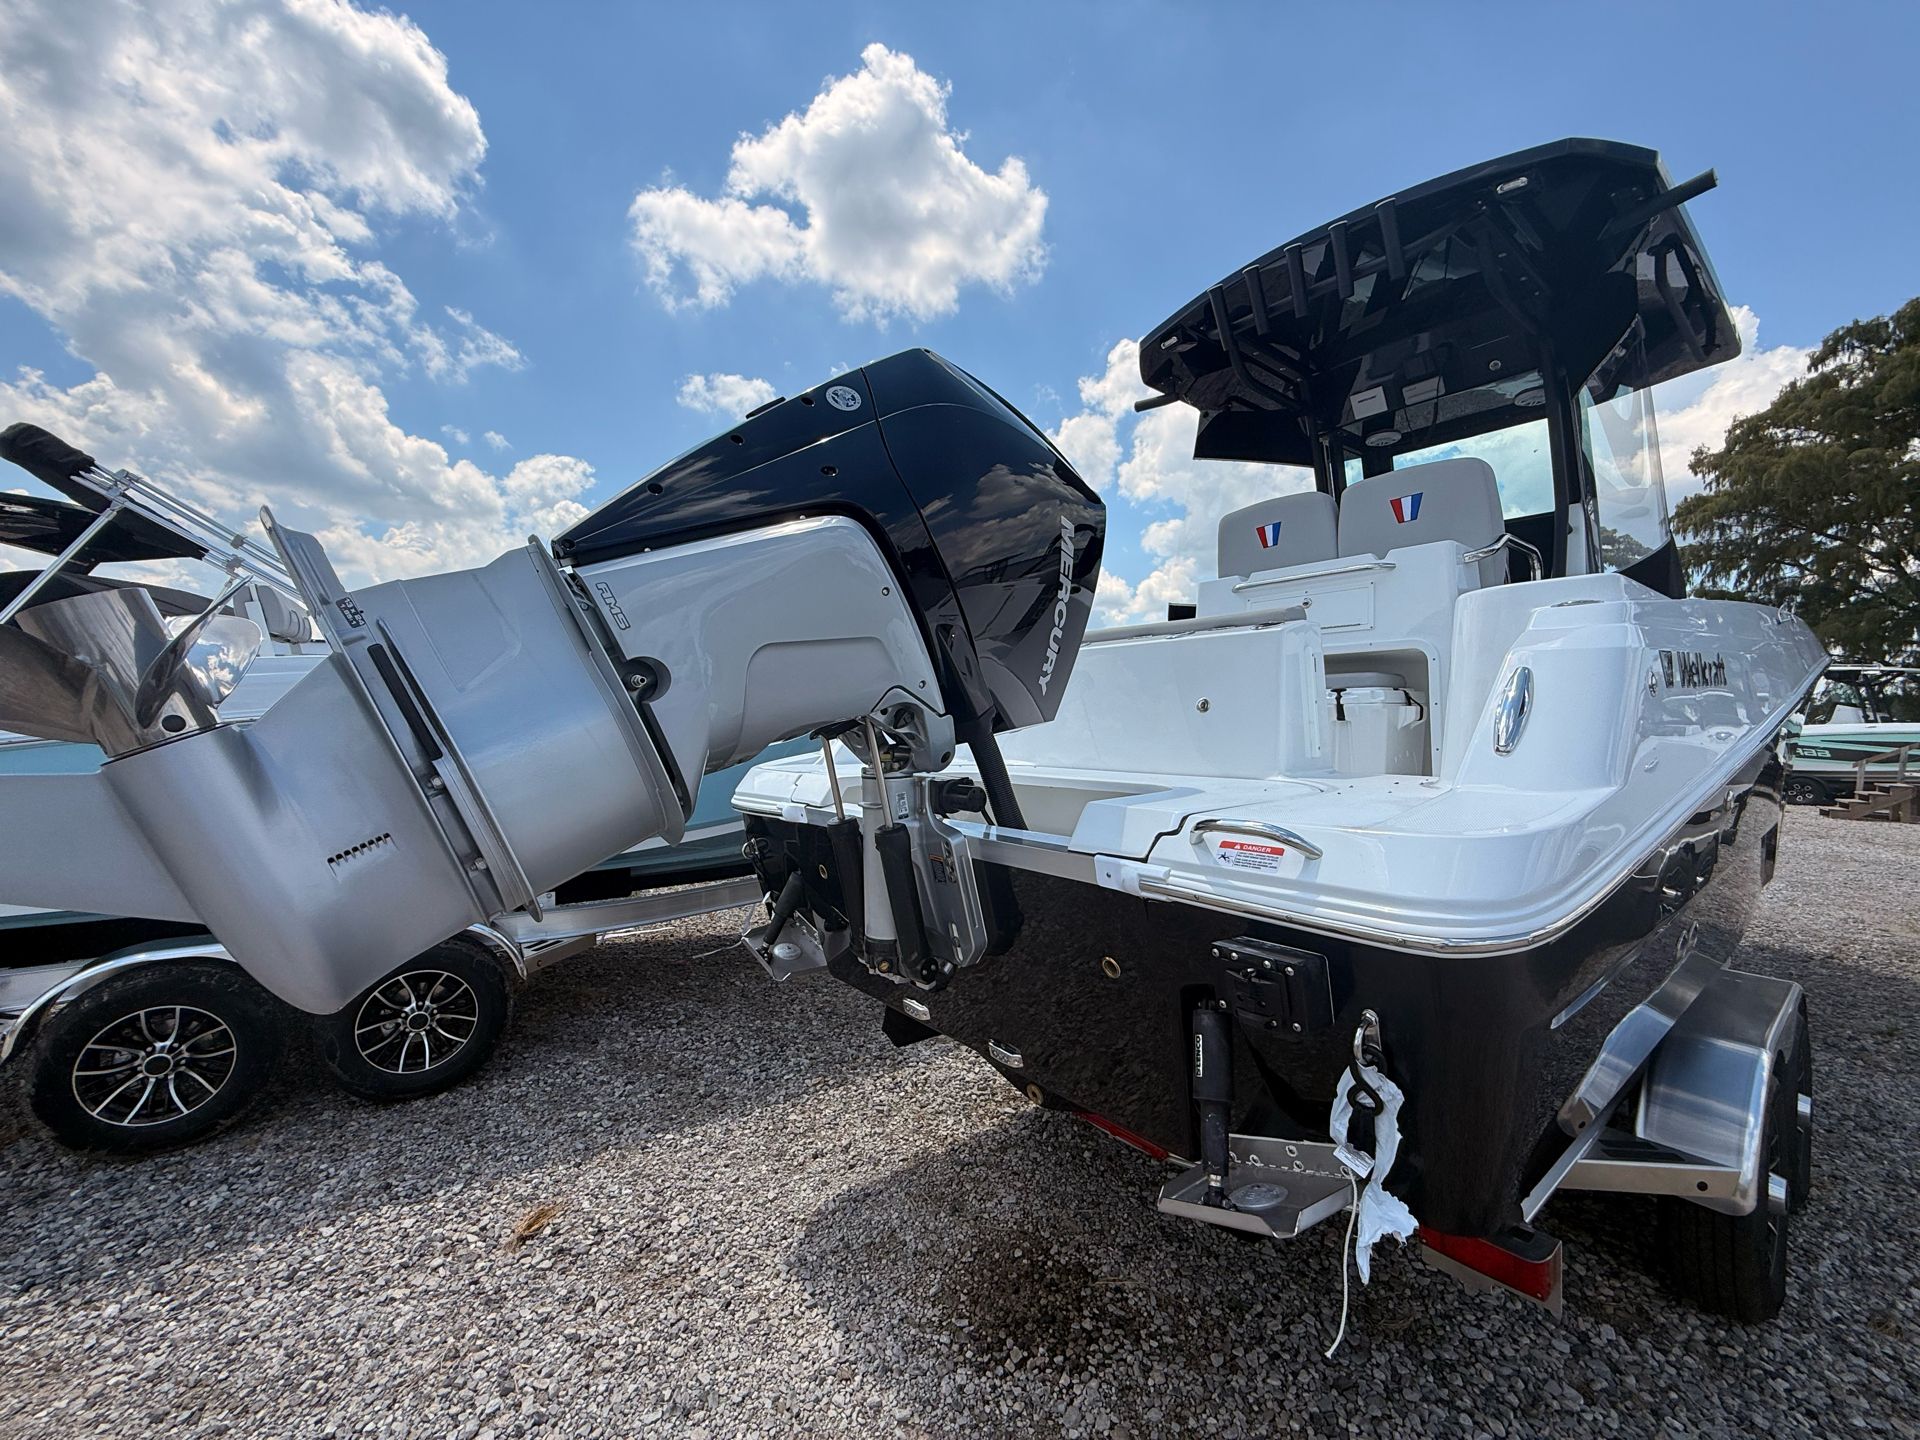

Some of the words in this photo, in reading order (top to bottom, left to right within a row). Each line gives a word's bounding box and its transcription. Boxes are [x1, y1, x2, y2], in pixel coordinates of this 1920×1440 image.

[595, 581, 631, 630] AMS
[1038, 515, 1075, 697] MERCURY
[1242, 844, 1273, 853] DANGER
